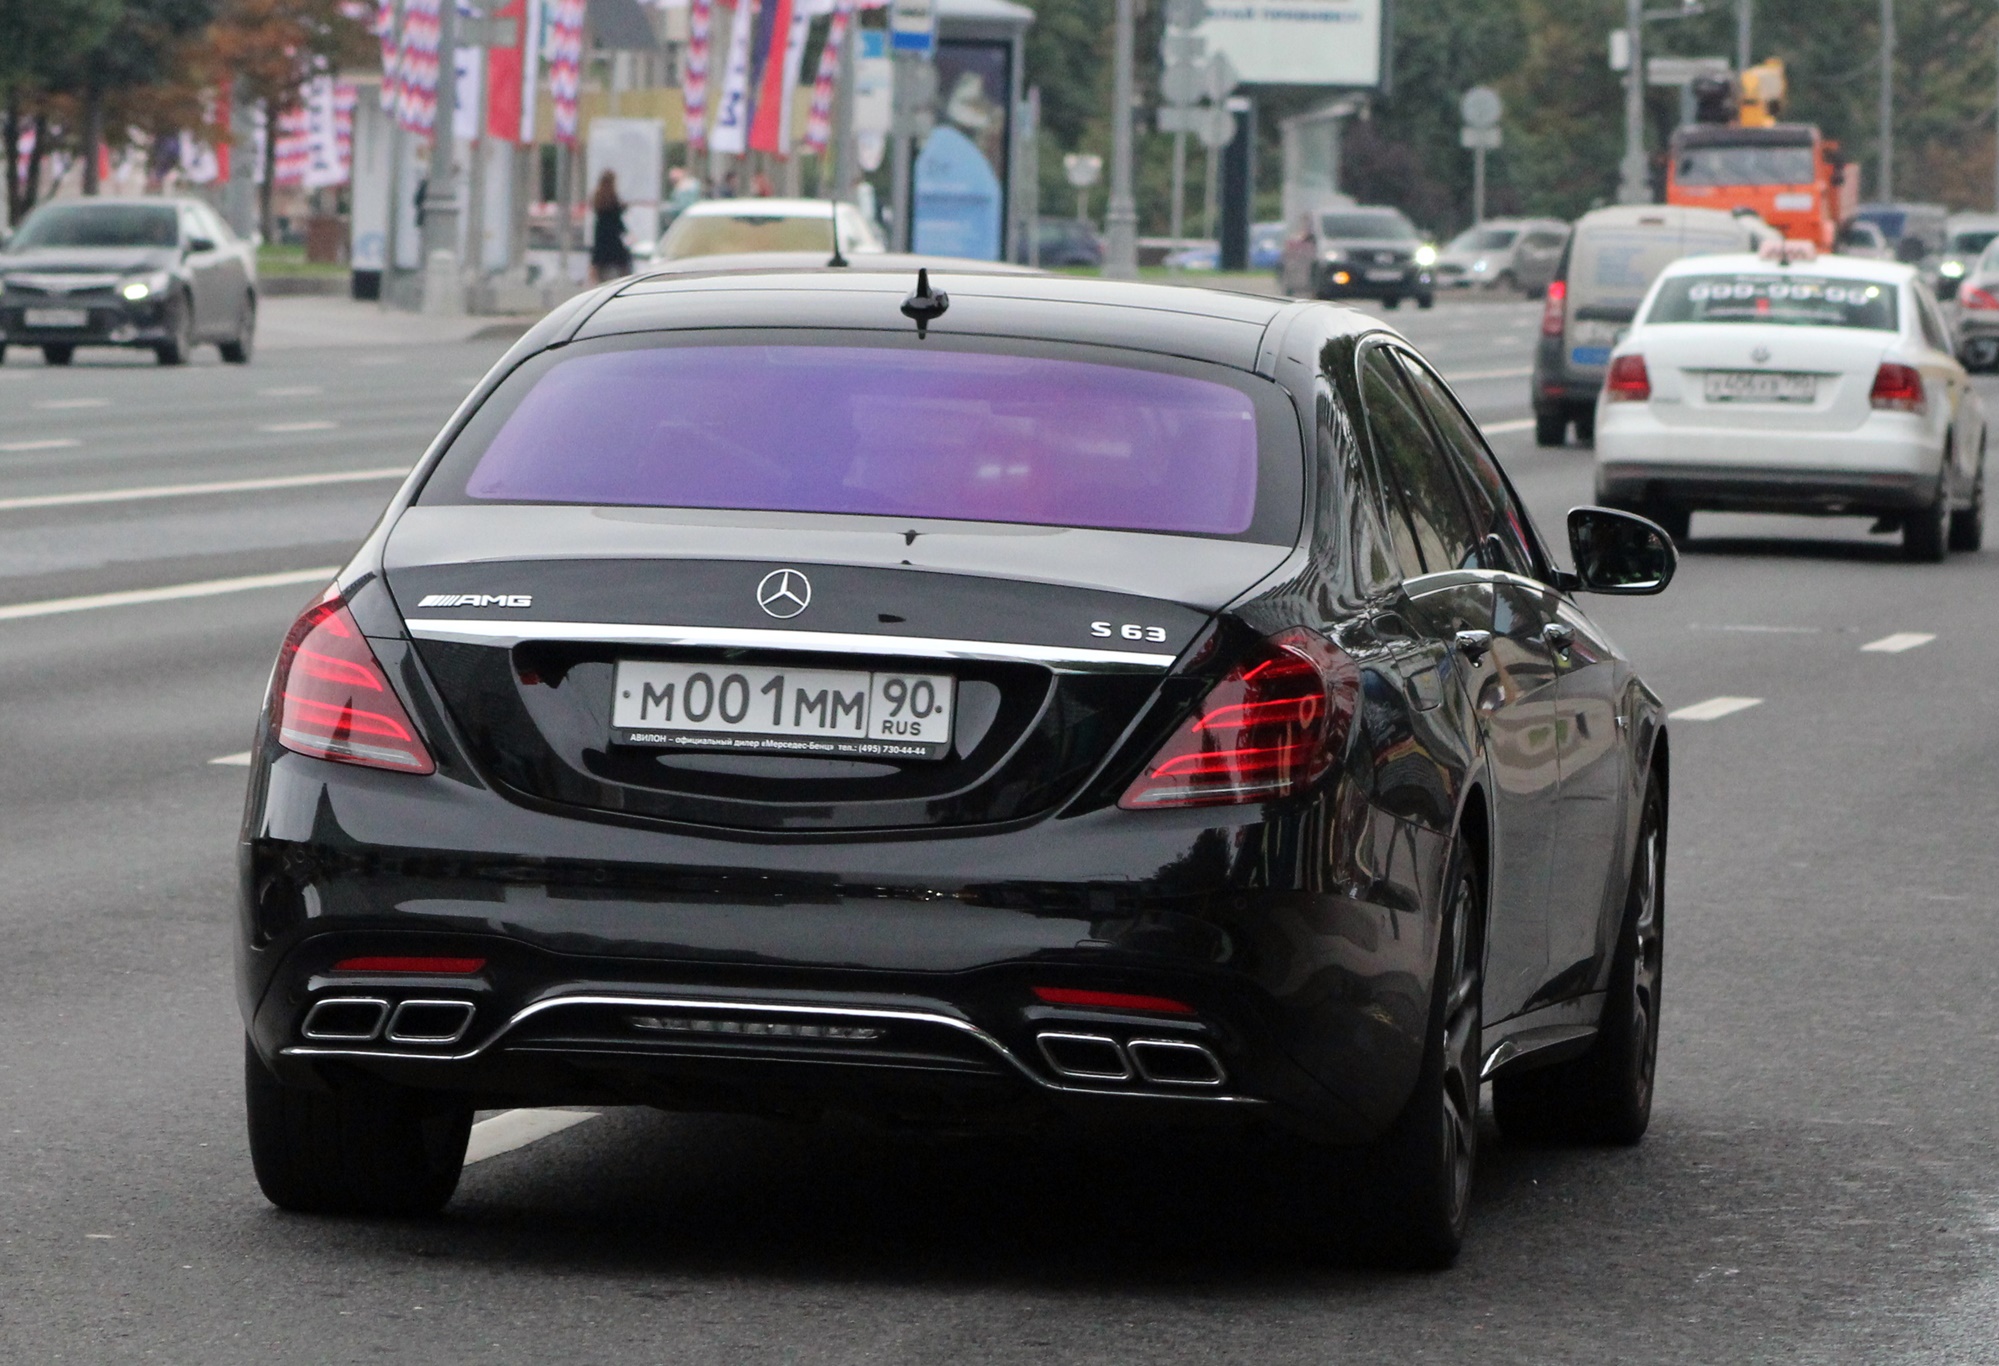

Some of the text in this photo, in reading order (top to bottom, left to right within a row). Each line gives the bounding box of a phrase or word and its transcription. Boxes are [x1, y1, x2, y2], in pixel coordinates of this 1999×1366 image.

[454, 594, 533, 608] AMG
[1090, 621, 1167, 643] S 63
[882, 678, 936, 719] 90
[881, 719, 922, 736] RUS
[629, 732, 667, 744] АВИЛОН
[674, 736, 733, 747] официальный
[733, 739, 760, 749] дилер
[858, 744, 882, 755] (495)
[882, 745, 927, 756] 730-44-44
